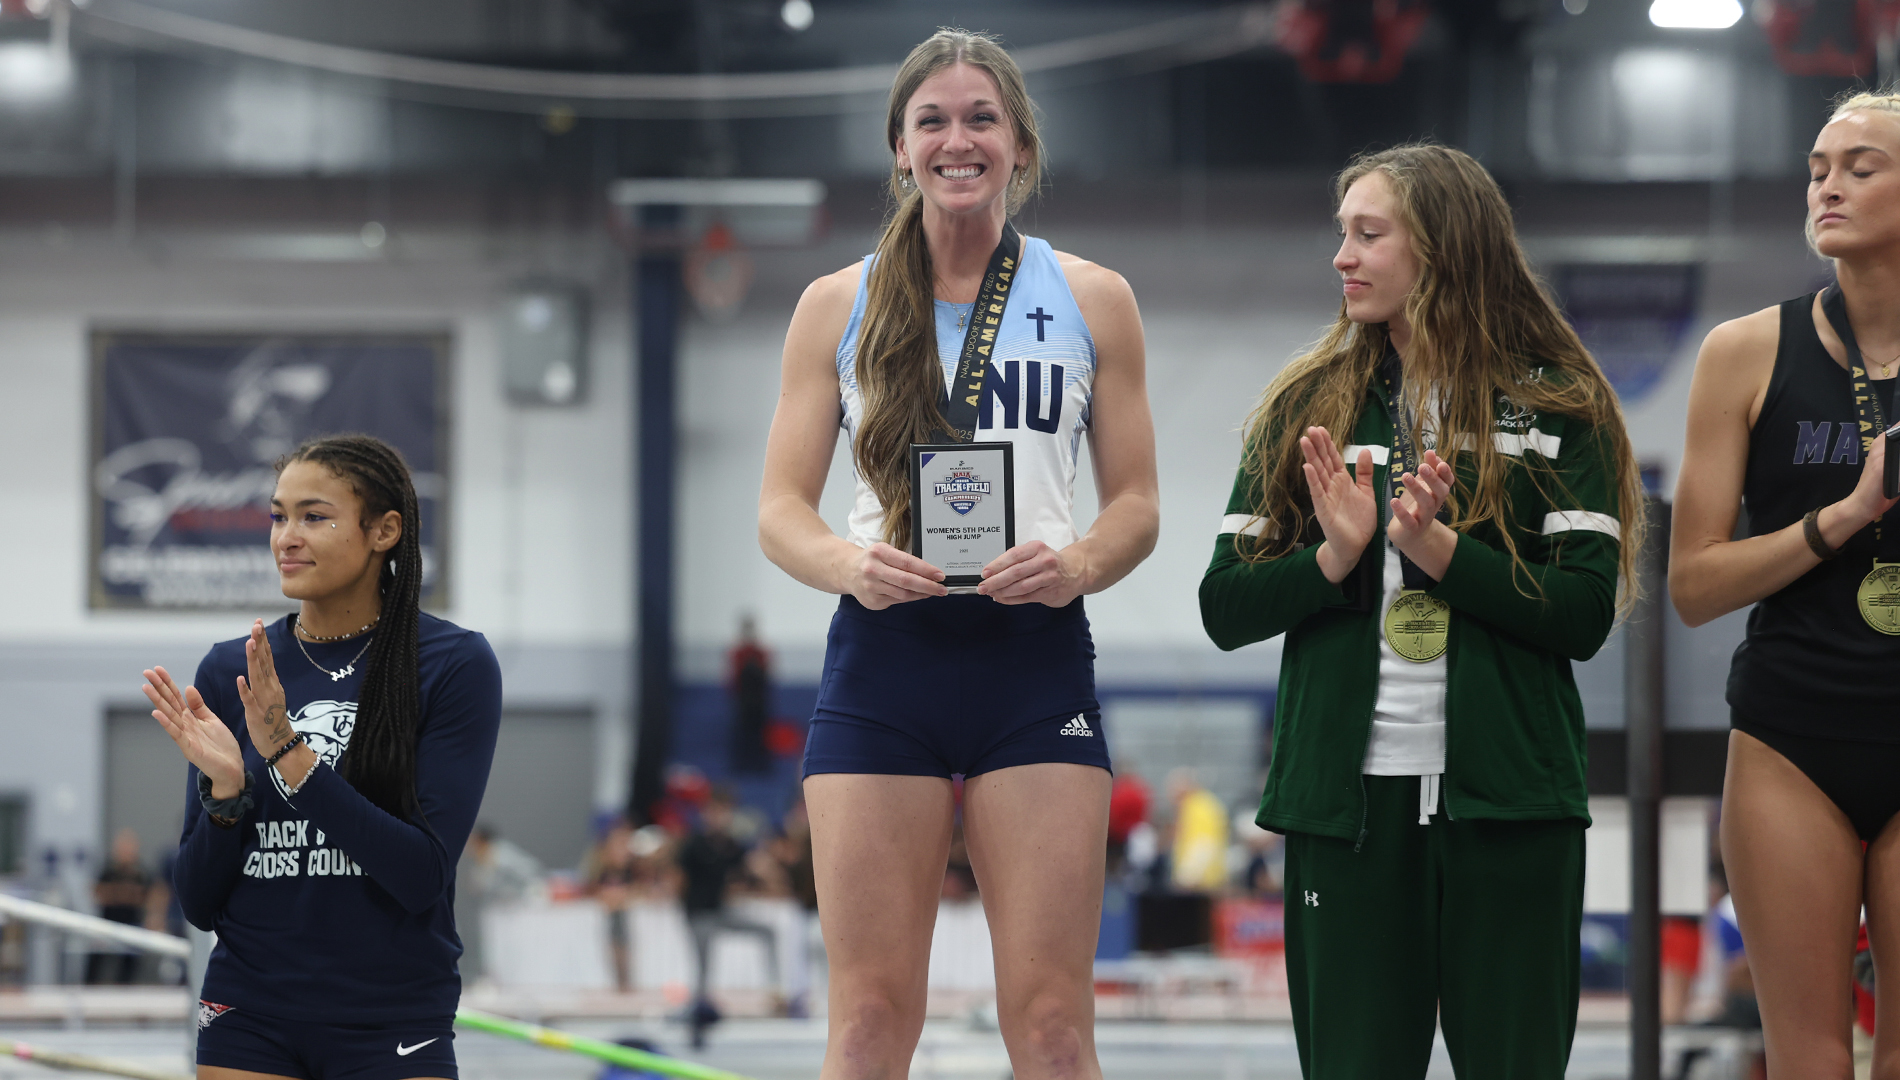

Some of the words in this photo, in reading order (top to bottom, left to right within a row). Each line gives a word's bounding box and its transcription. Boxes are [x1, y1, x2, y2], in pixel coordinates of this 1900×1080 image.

[984, 272, 995, 293] FIELD
[974, 301, 988, 325] TRACK
[965, 256, 1015, 407] ALL-AMERICAN
[965, 325, 981, 359] INDOOR
[960, 359, 971, 379] NAIA
[979, 360, 1065, 434] NU
[1871, 393, 1880, 413] NAIA
[1852, 366, 1875, 452] ALL-AM
[948, 428, 973, 440] 025
[1494, 419, 1517, 428] RACK
[1874, 415, 1884, 436] INDO
[1793, 421, 1859, 465] MA
[1404, 446, 1415, 470] TRACK
[935, 483, 962, 494] TRACK
[966, 482, 990, 493] FIELD
[332, 715, 353, 738] UC
[1060, 727, 1094, 737] adidas
[307, 849, 368, 876] COUN
